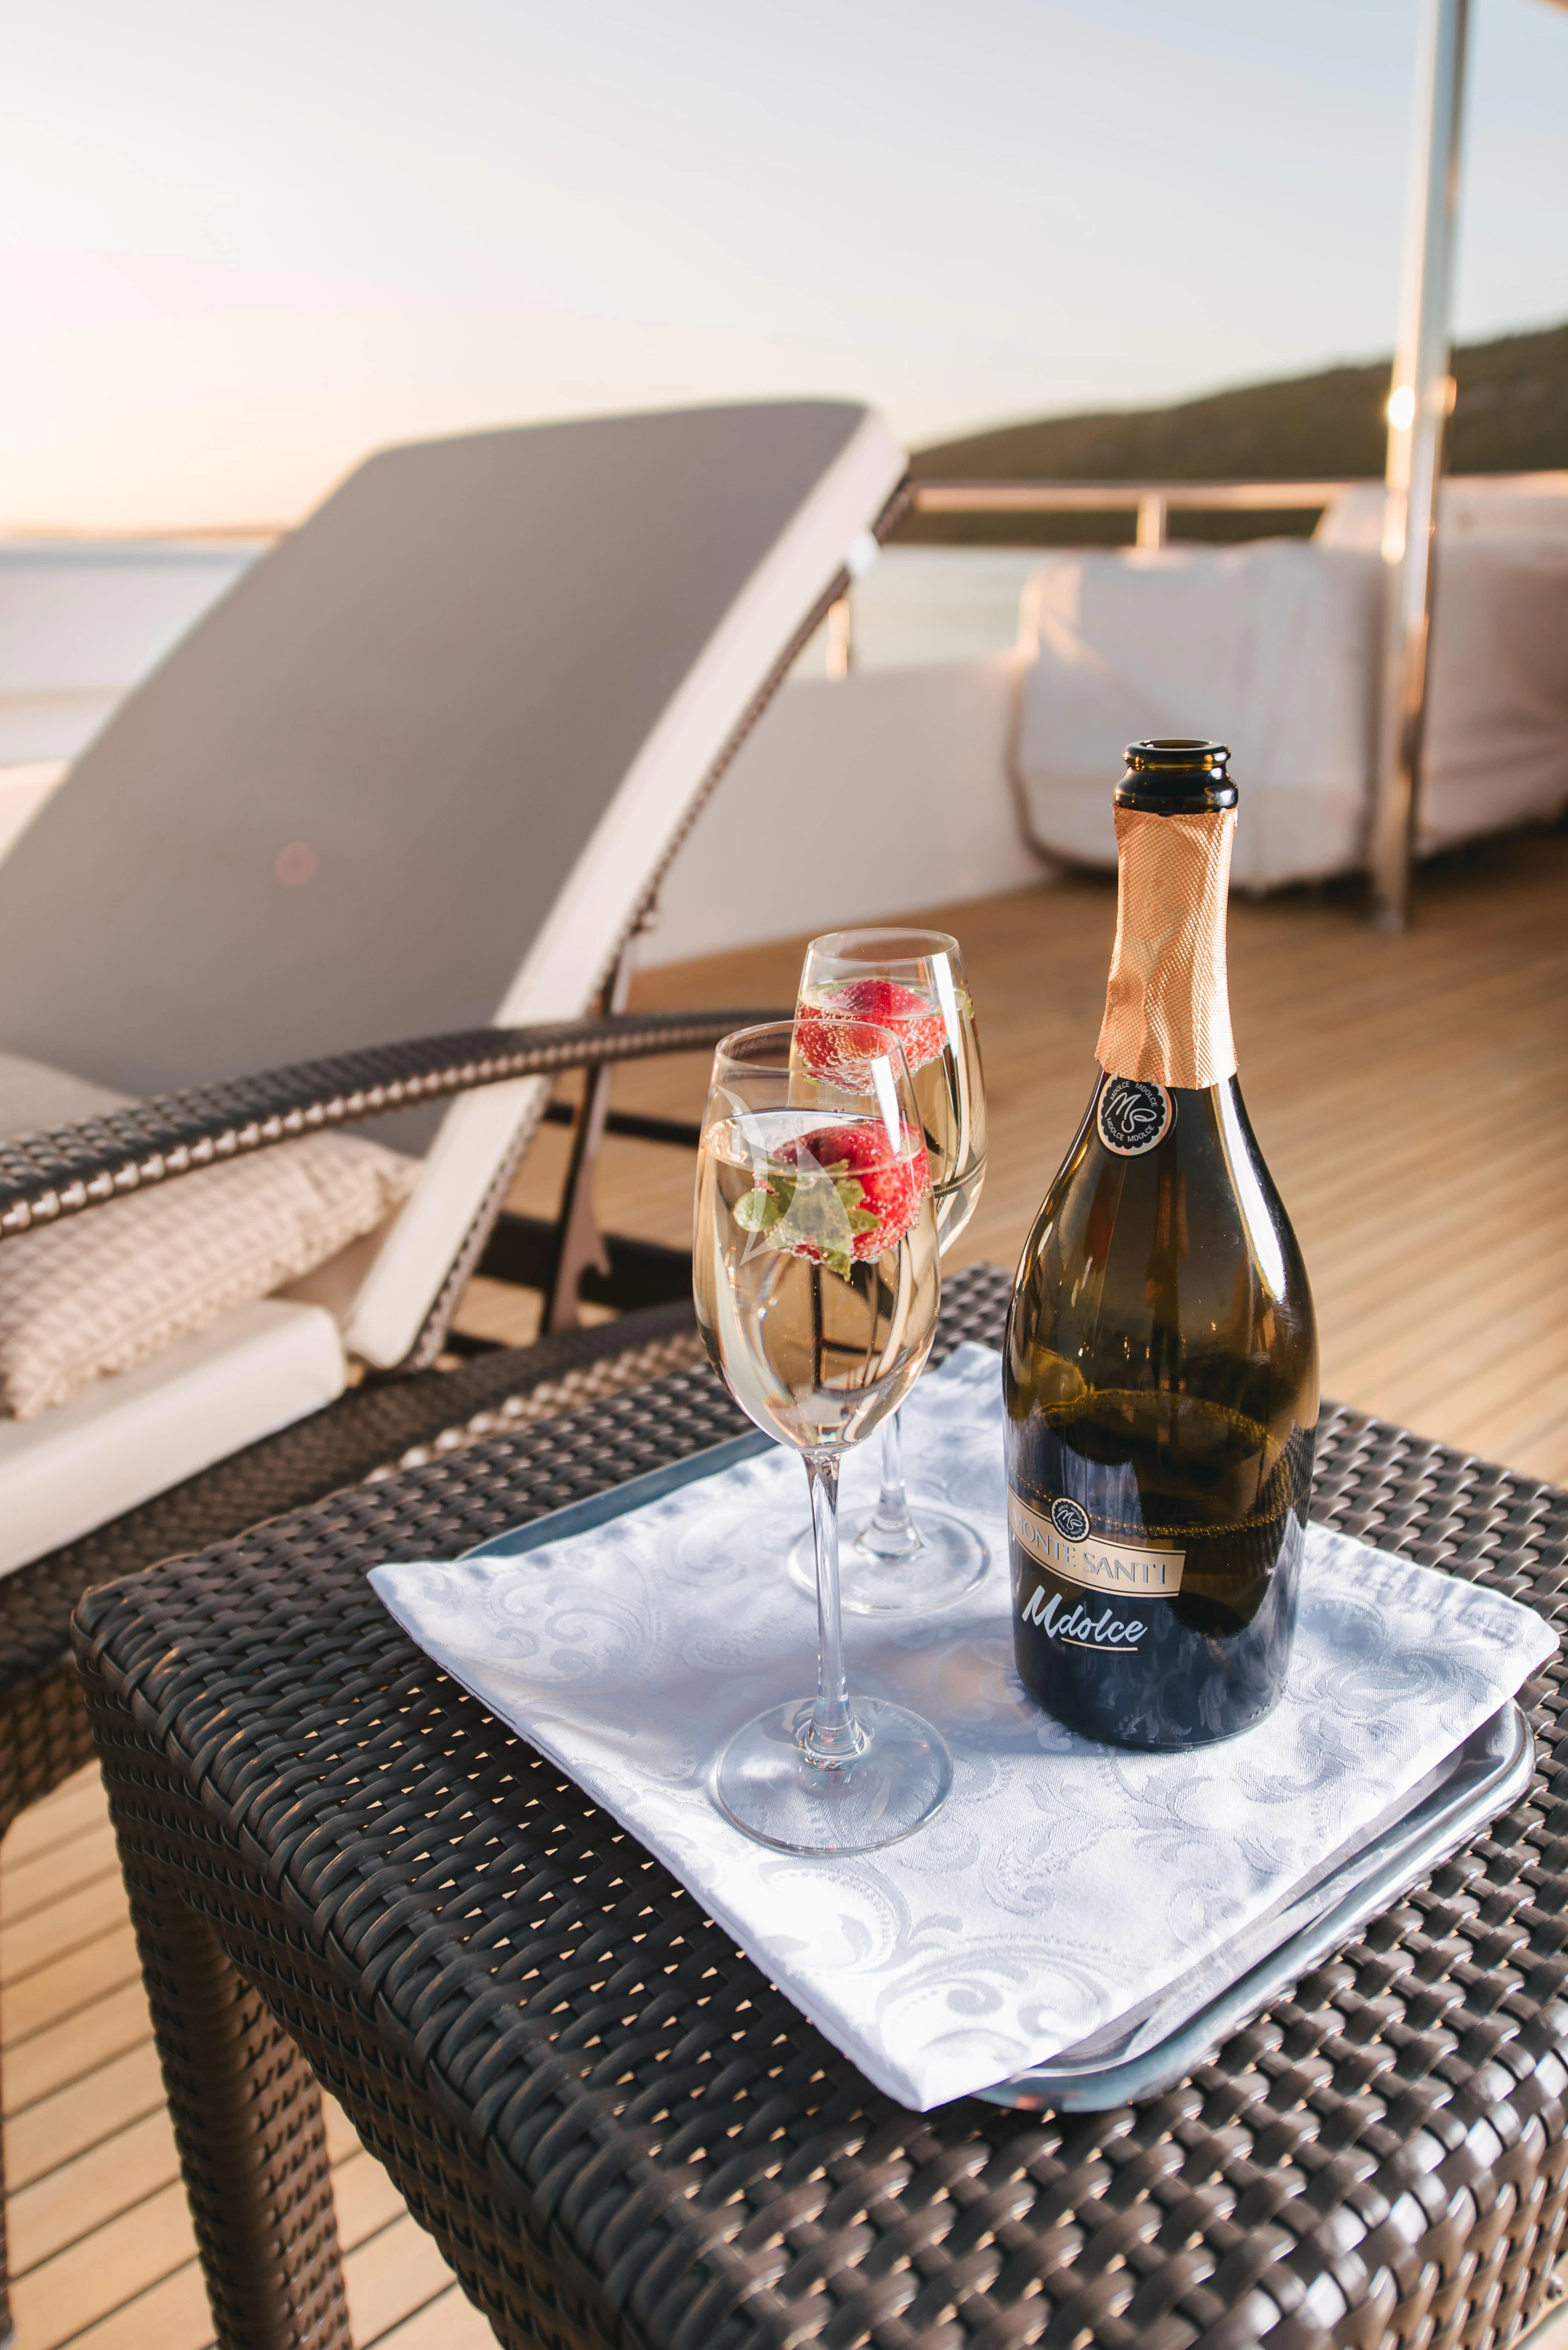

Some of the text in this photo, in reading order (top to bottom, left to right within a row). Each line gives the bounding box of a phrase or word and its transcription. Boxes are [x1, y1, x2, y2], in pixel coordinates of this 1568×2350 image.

[1110, 1081, 1130, 1101] MDOLCE
[1135, 1082, 1158, 1107] MDOLCE
[1106, 1117, 1125, 1141] MDOLCE
[1127, 1124, 1155, 1142] MDOLCE
[1071, 1506, 1082, 1520] MDOLCE
[1013, 1504, 1165, 1584] MONTE SANTI
[1022, 1585, 1148, 1643] Mdolce
